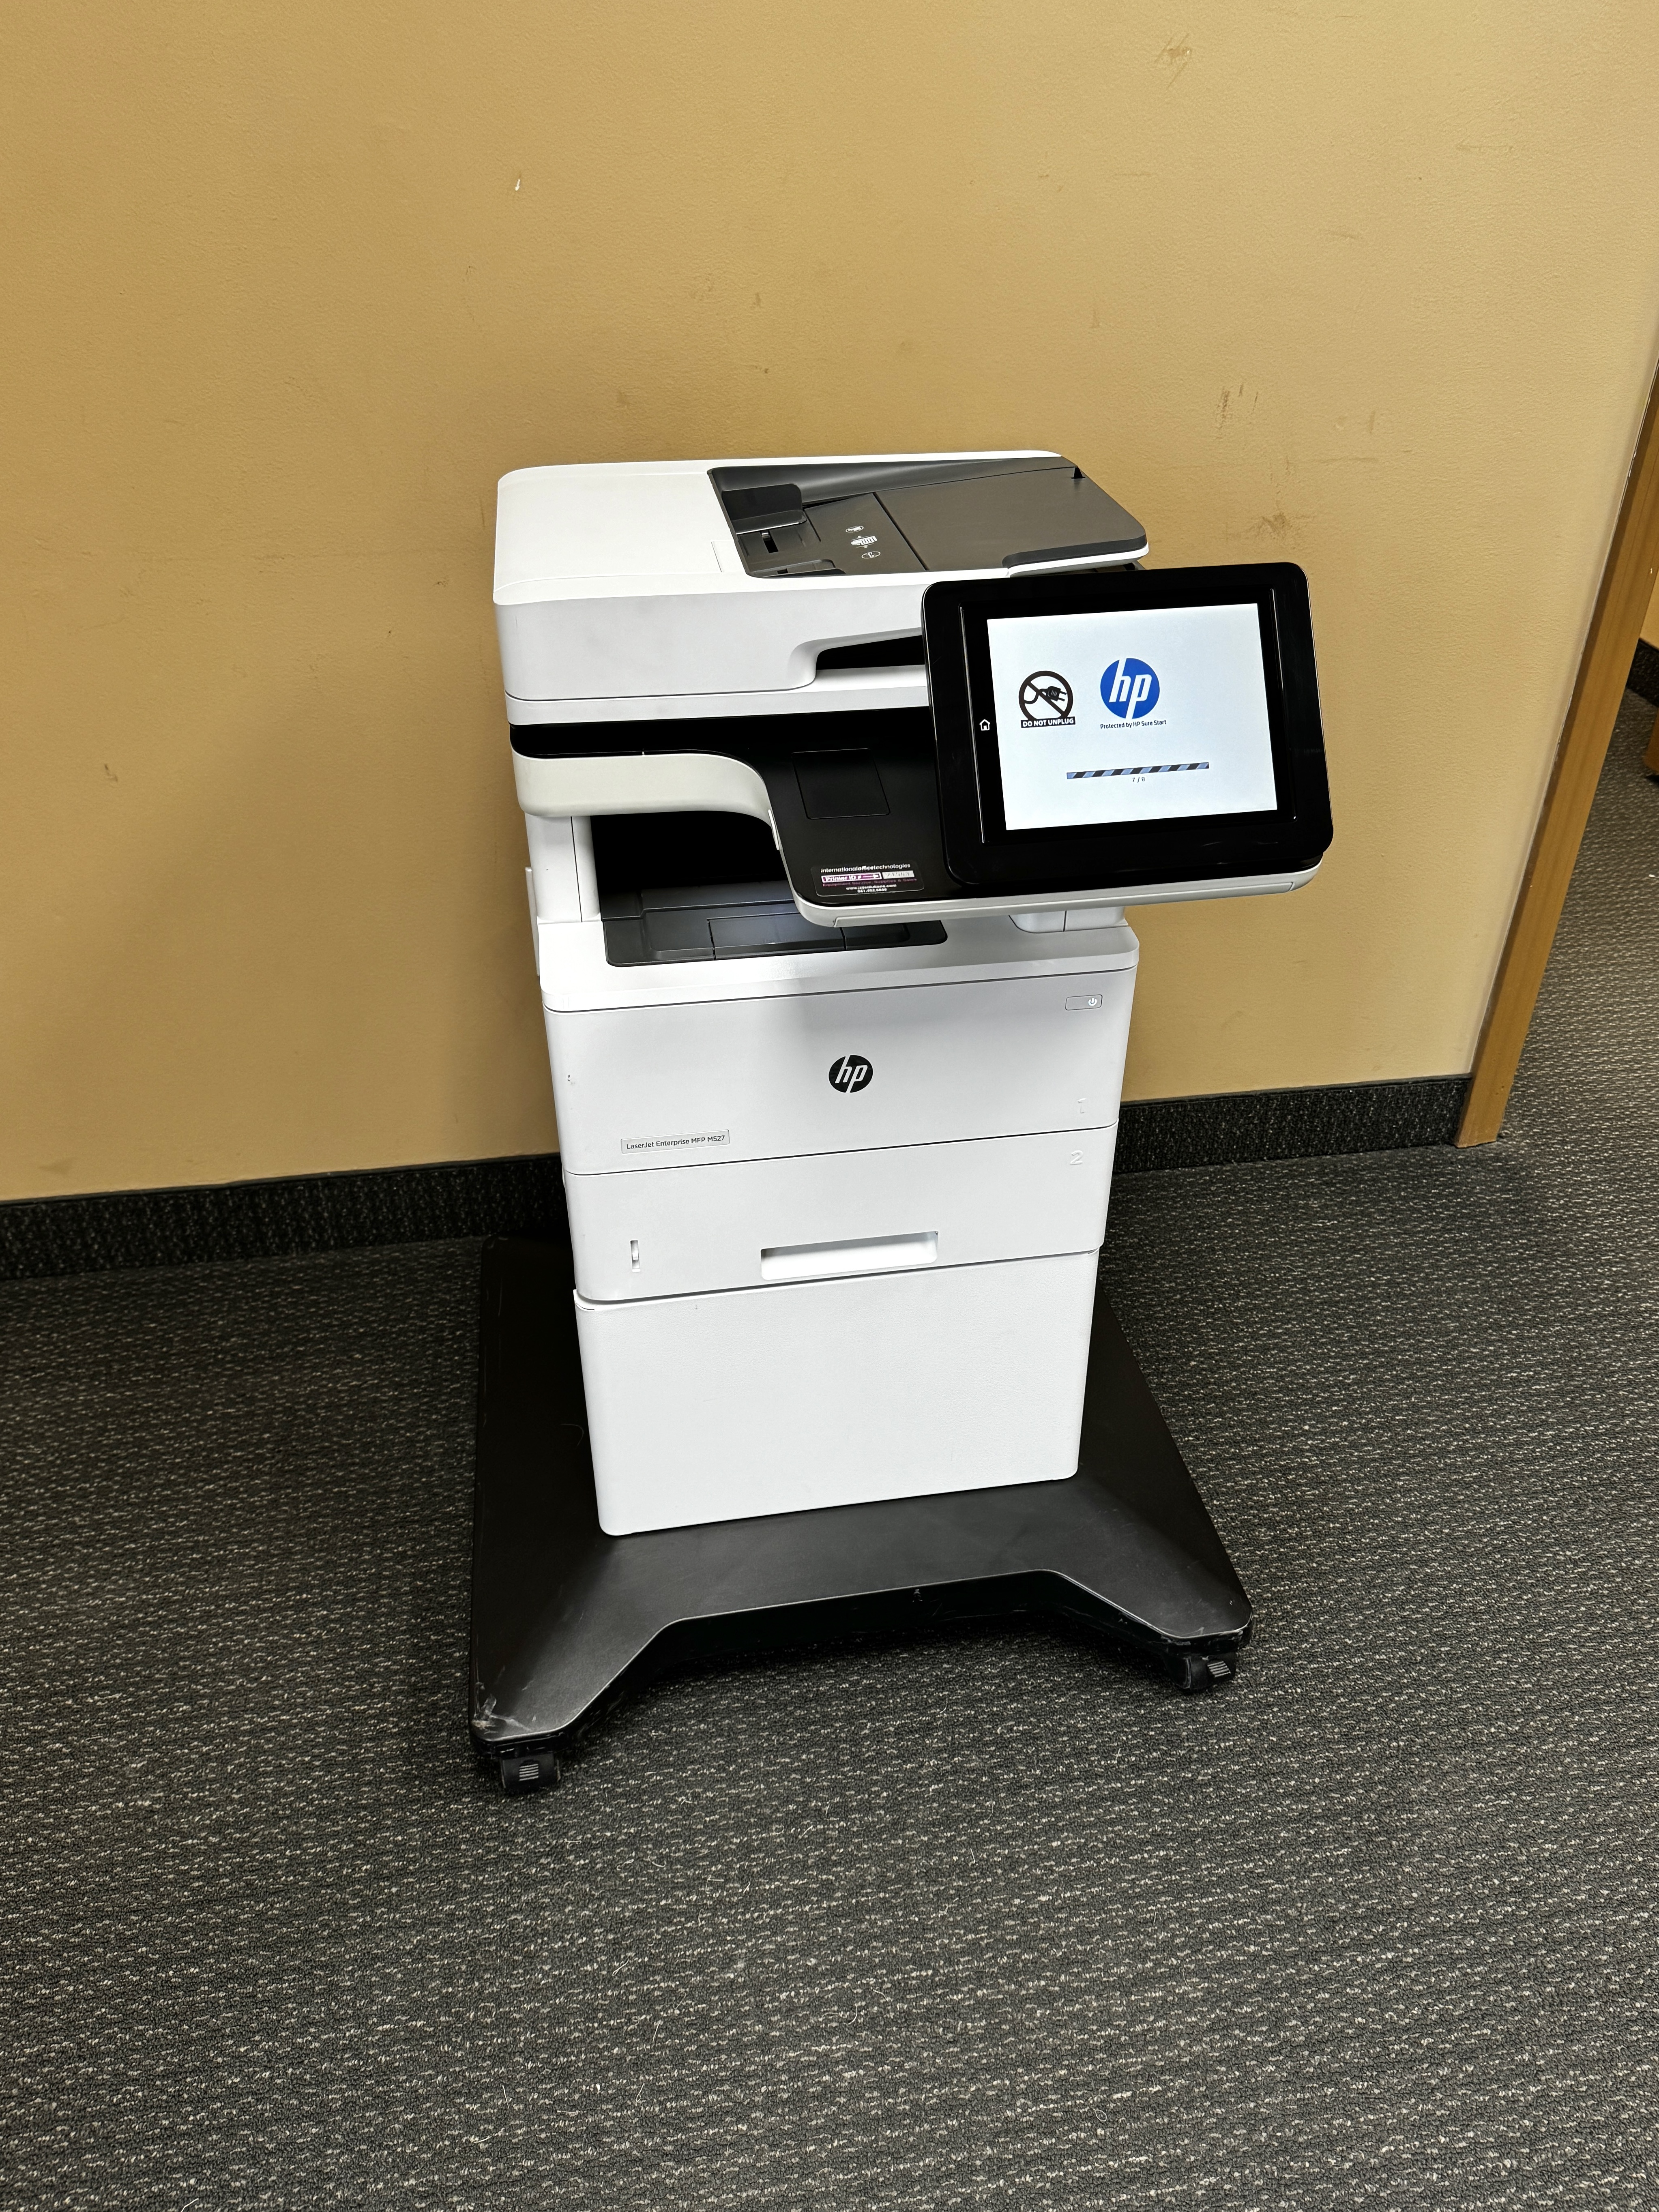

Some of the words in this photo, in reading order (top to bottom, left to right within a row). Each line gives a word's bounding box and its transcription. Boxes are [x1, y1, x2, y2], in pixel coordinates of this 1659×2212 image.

[1109, 657, 1152, 719] hp
[835, 1055, 868, 1093] hp
[656, 1139, 689, 1147] Enterprise
[1070, 1150, 1083, 1165] 2
